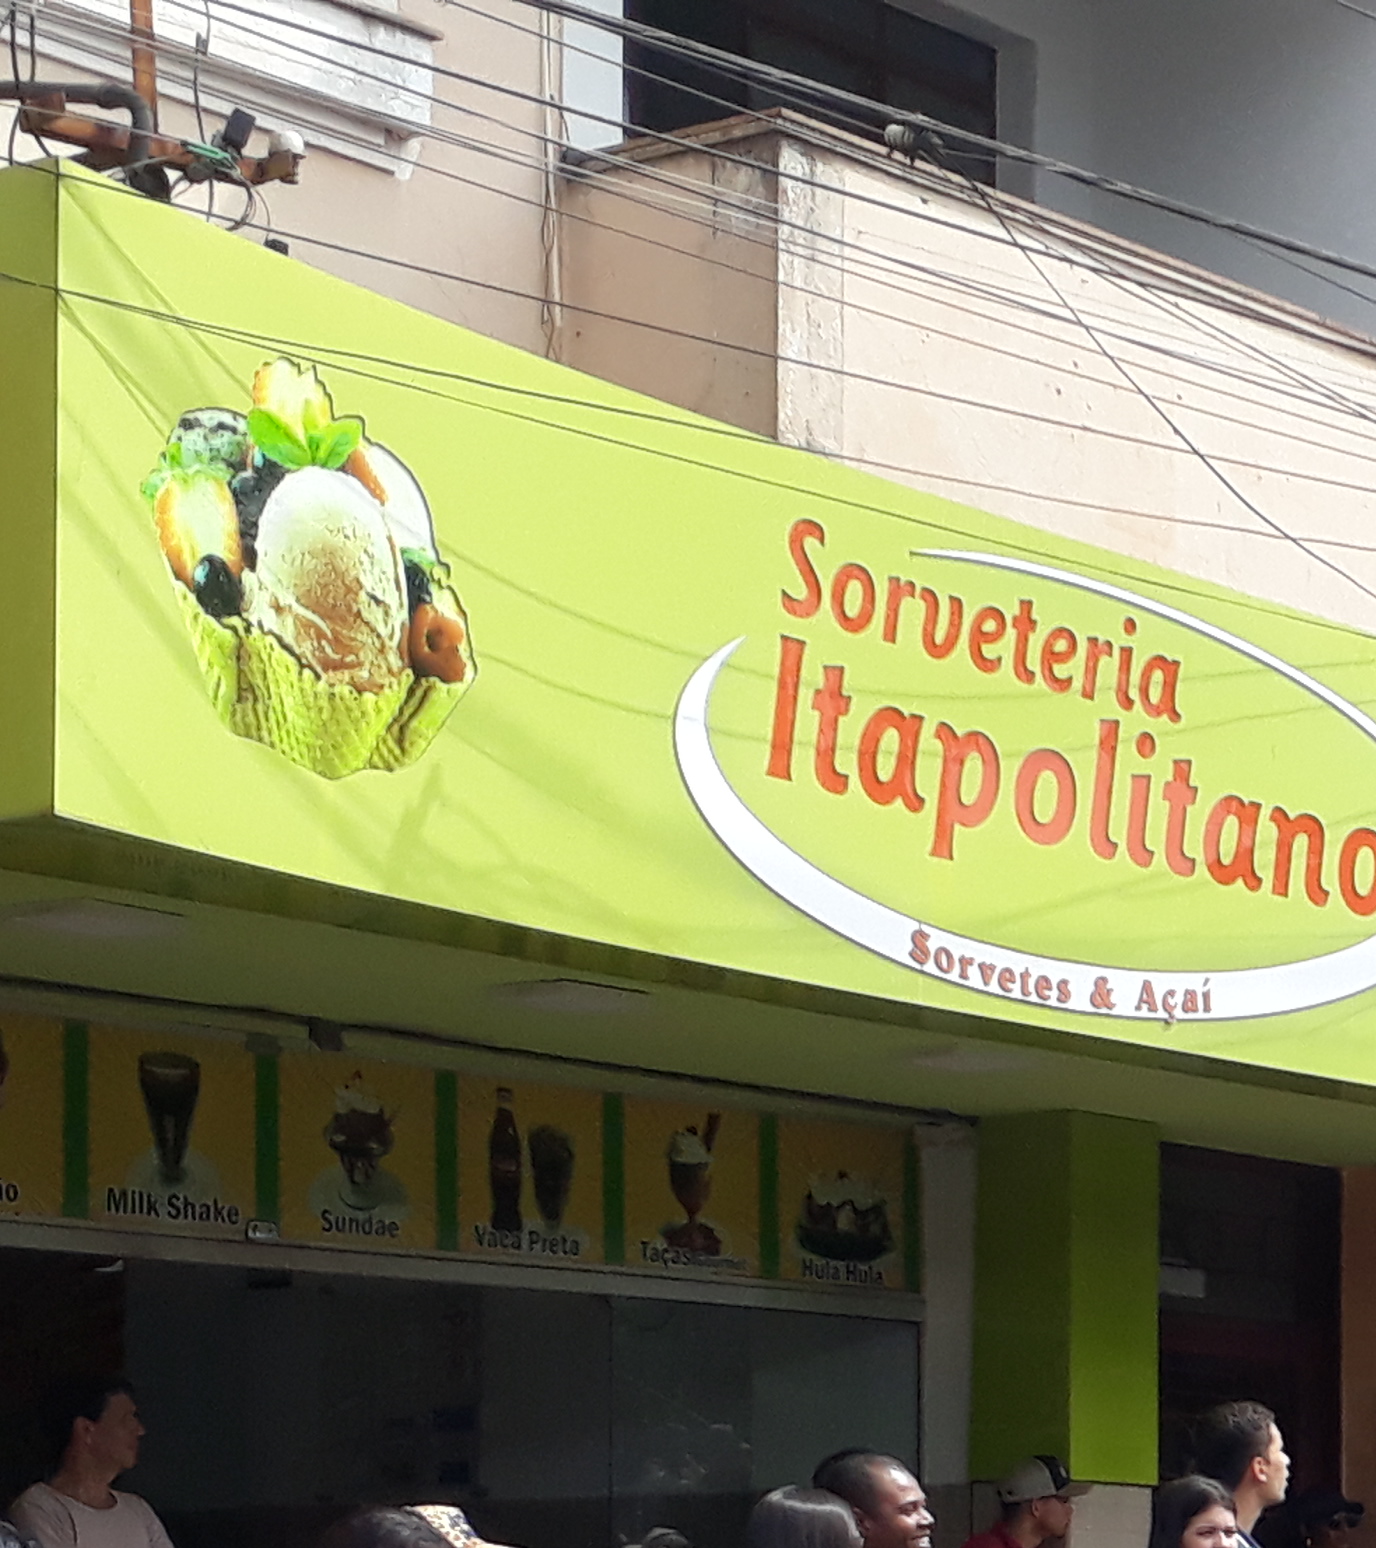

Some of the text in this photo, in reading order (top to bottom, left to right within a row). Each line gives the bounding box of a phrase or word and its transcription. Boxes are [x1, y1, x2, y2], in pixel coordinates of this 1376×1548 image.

[781, 518, 1184, 724] Sorveteria
[909, 929, 1212, 1022] Sorvetes & Açaí
[106, 1186, 240, 1226] Milk Shake
[320, 1209, 401, 1239] Sundae
[474, 1223, 522, 1252] Vaca
[640, 1239, 691, 1269] Taças
[801, 1258, 885, 1286] Hula Hula
